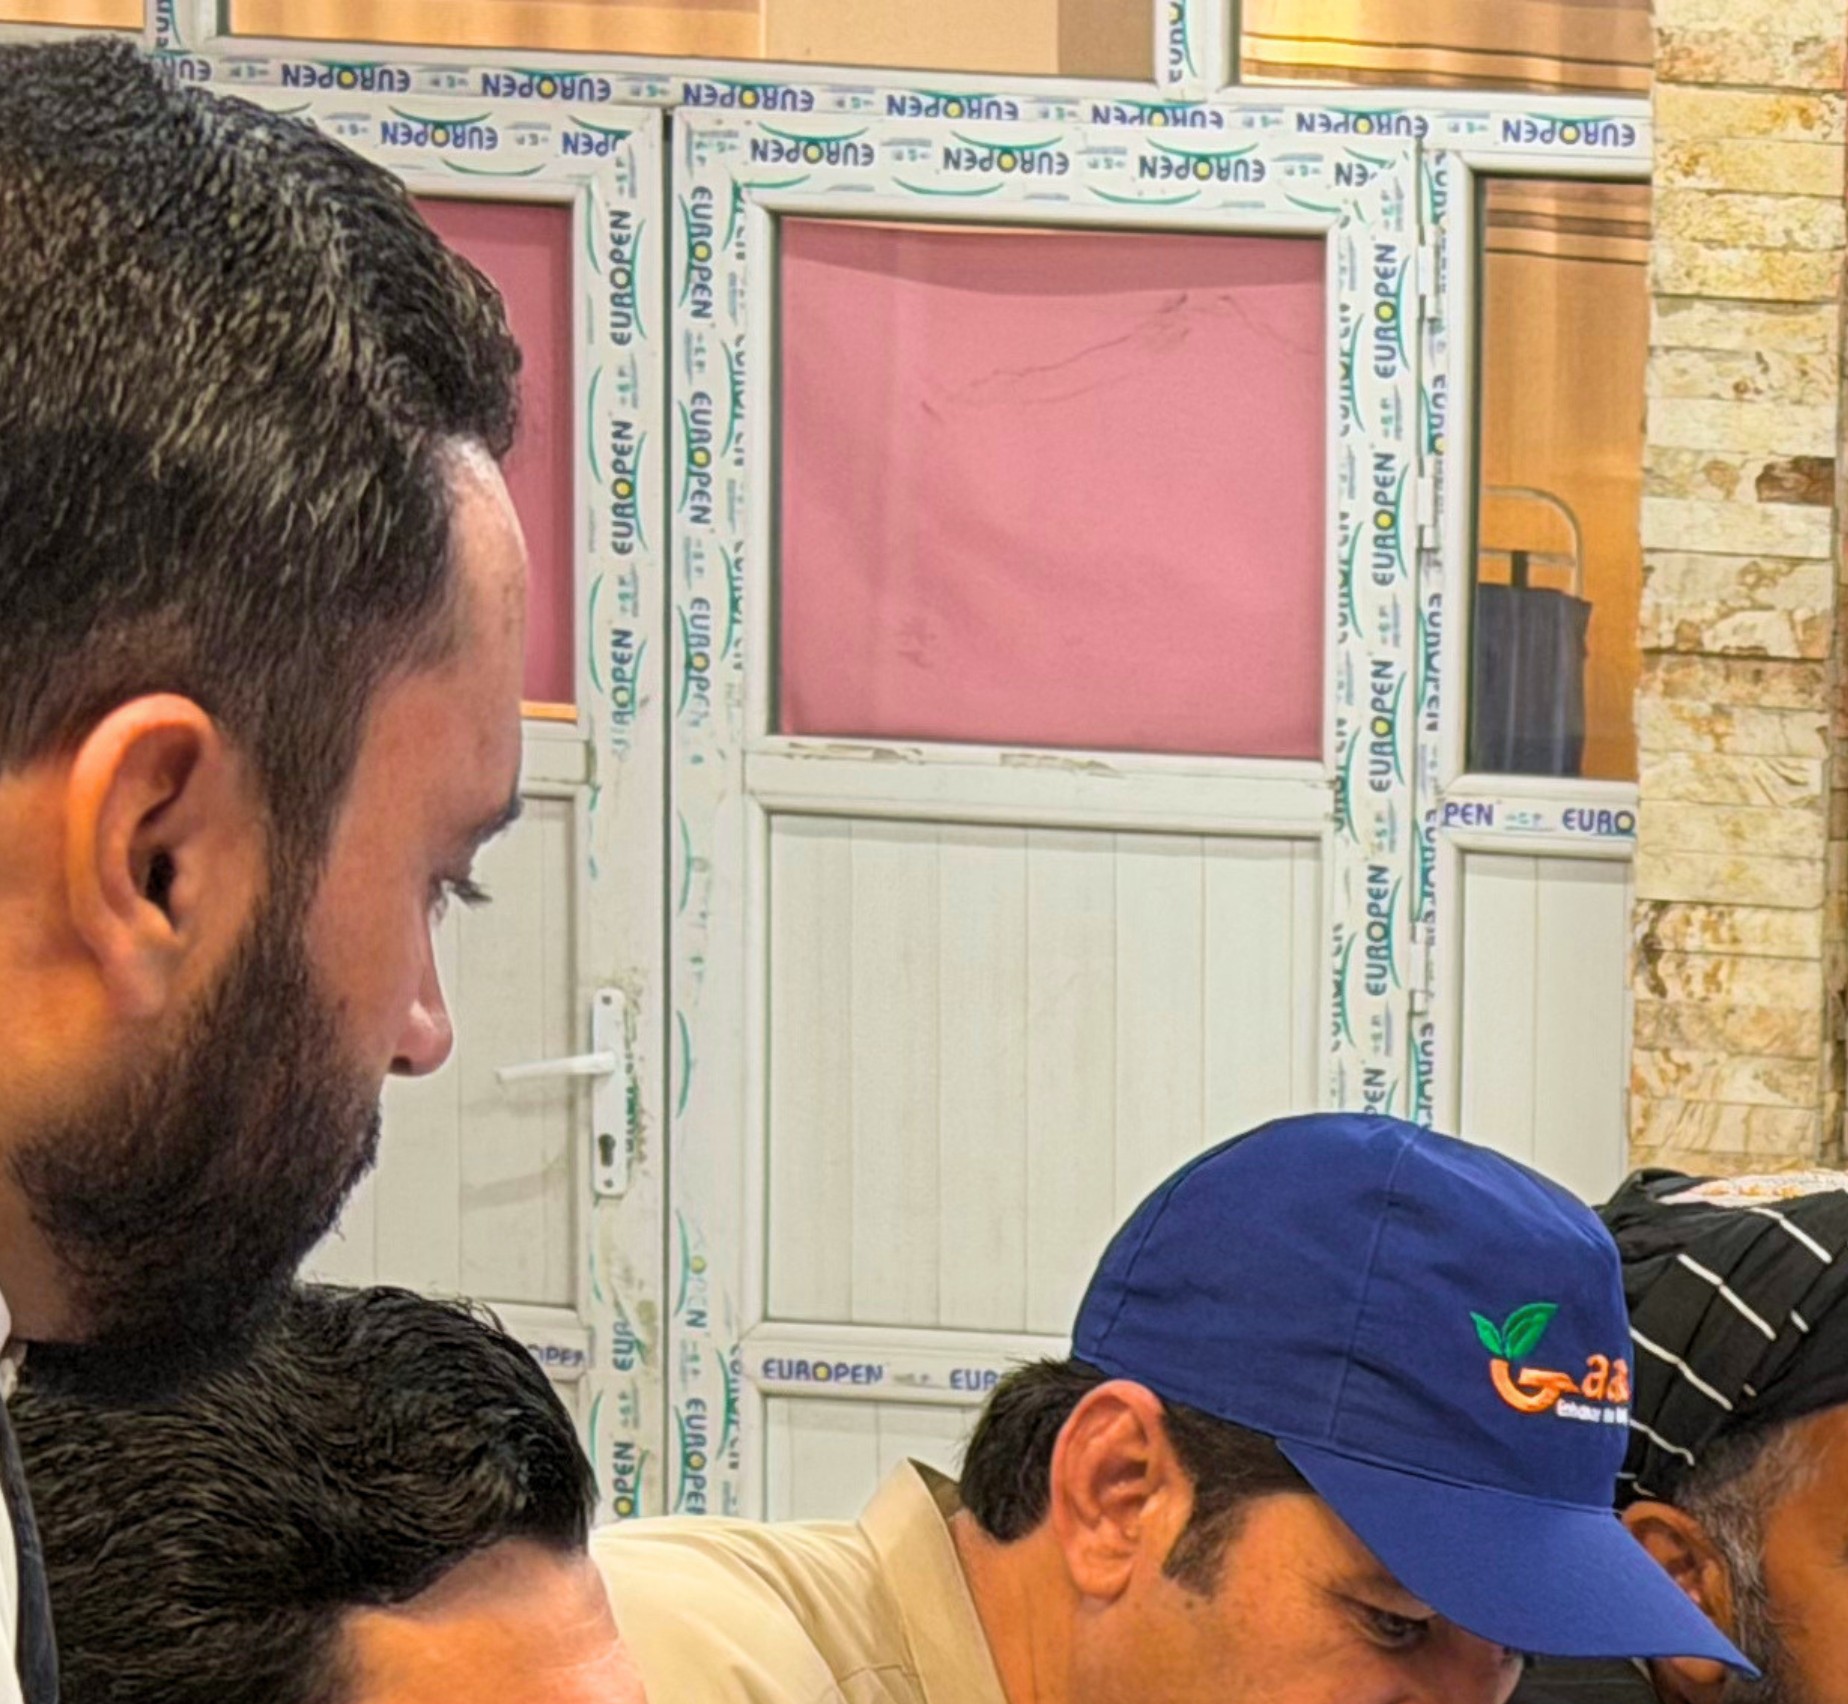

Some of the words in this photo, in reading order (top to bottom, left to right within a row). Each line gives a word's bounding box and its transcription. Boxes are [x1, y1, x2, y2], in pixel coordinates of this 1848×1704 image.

[281, 62, 411, 92] EUROPEN
[480, 72, 611, 102] EUROPEN
[682, 80, 815, 112] EUROPEN
[887, 92, 1019, 122] EUROPEN
[1091, 104, 1224, 129] EUROPEN
[1297, 111, 1429, 140] EUROPEN
[381, 120, 498, 151] EUROPEN
[1503, 117, 1636, 148] EUROPEN
[750, 136, 875, 167] EUROPEN
[942, 146, 1070, 176] EUROPEN
[1138, 154, 1266, 183] EUROPEN
[690, 185, 713, 320] EUROPEN
[610, 209, 633, 347] EUROPEN
[1373, 242, 1398, 380] EUROPEN
[689, 392, 712, 525] EUROPEN
[611, 419, 634, 557] EUROPEN
[1371, 450, 1397, 588] EUROPEN
[1369, 659, 1395, 793] EUROPEN
[1365, 864, 1390, 997] EUROPEN
[762, 1358, 884, 1385] EUROPEN
